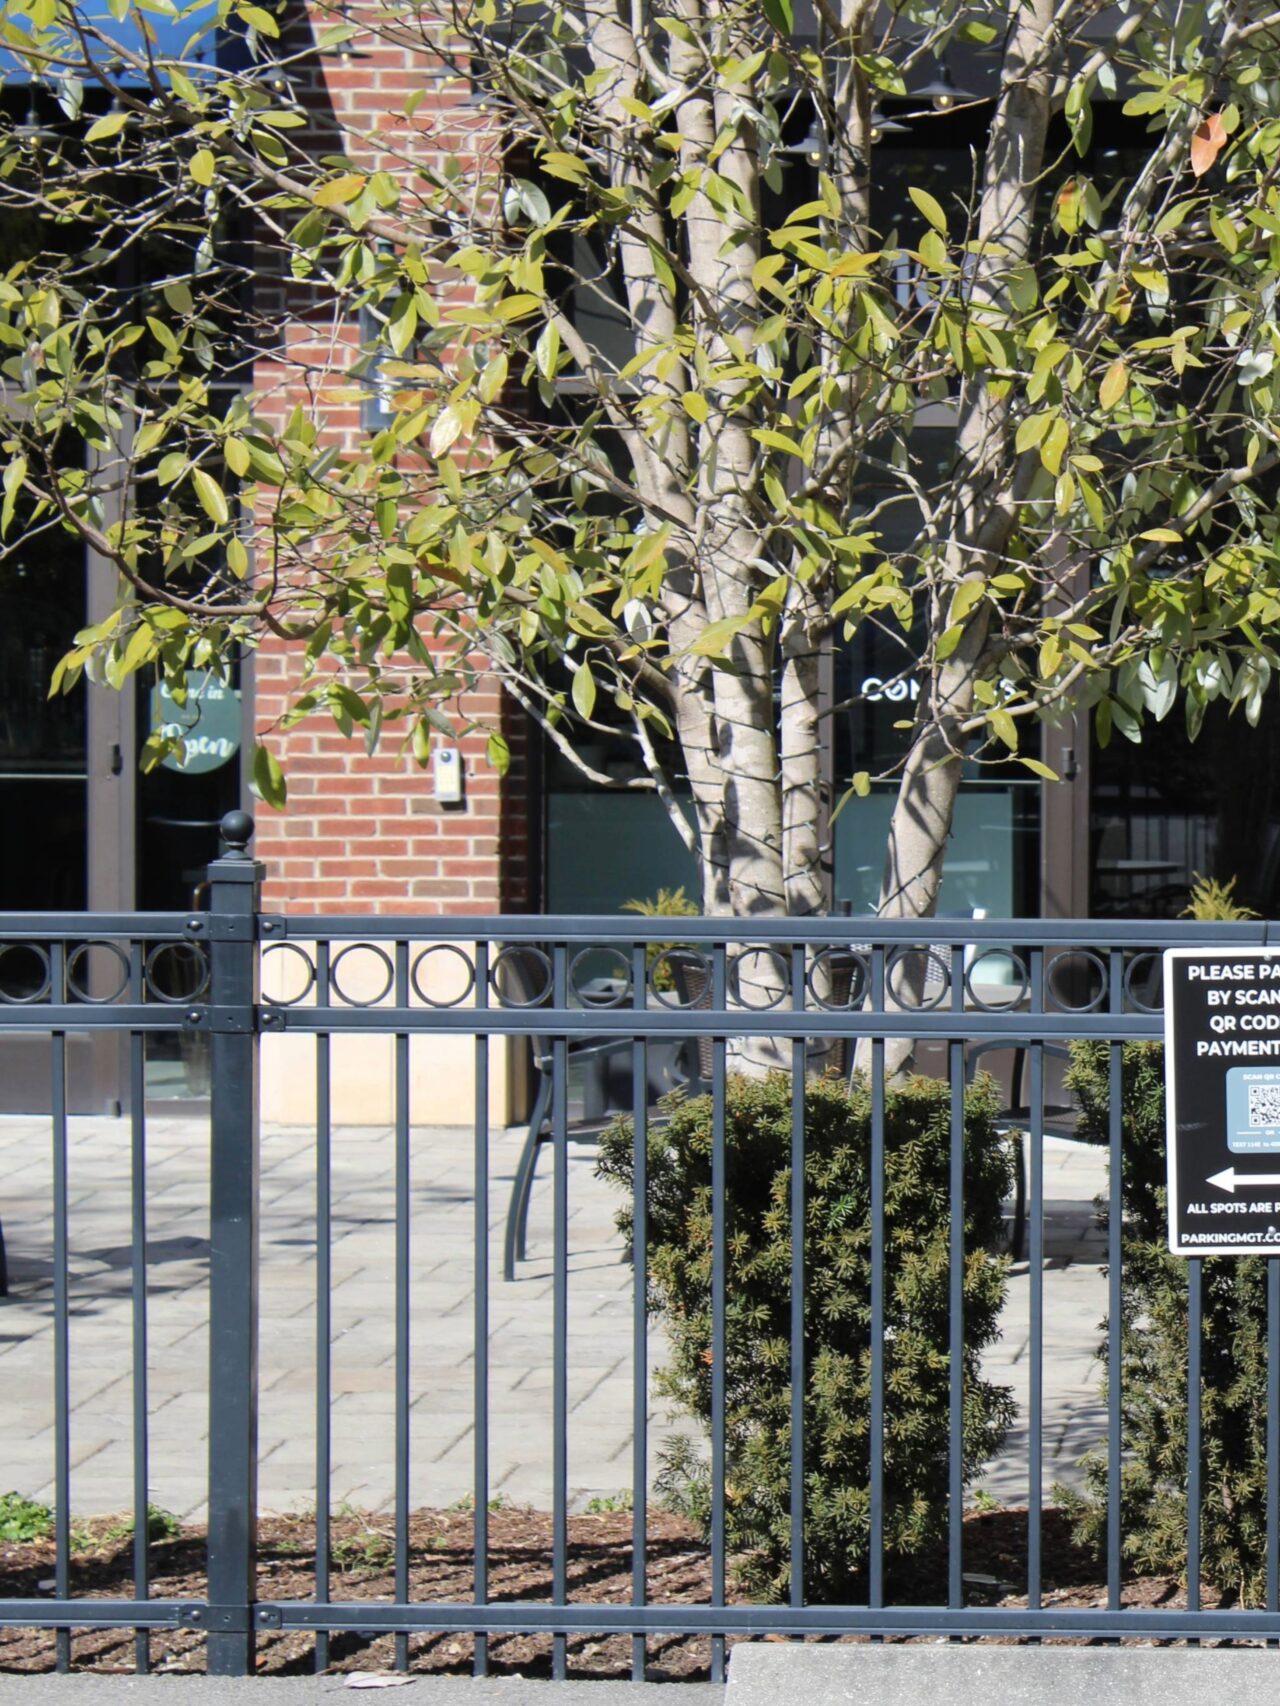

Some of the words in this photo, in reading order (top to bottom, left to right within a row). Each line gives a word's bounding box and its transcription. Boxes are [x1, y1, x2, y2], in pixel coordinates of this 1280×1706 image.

[206, 685, 225, 700] in
[1187, 964, 1255, 981] PLEASE
[1207, 990, 1231, 1006] BY
[1209, 1015, 1236, 1033] QR
[1263, 1073, 1275, 1082] QR
[1186, 1203, 1209, 1214] ALL
[1210, 1202, 1247, 1214] SPOTS
[1248, 1202, 1273, 1213] ARE
